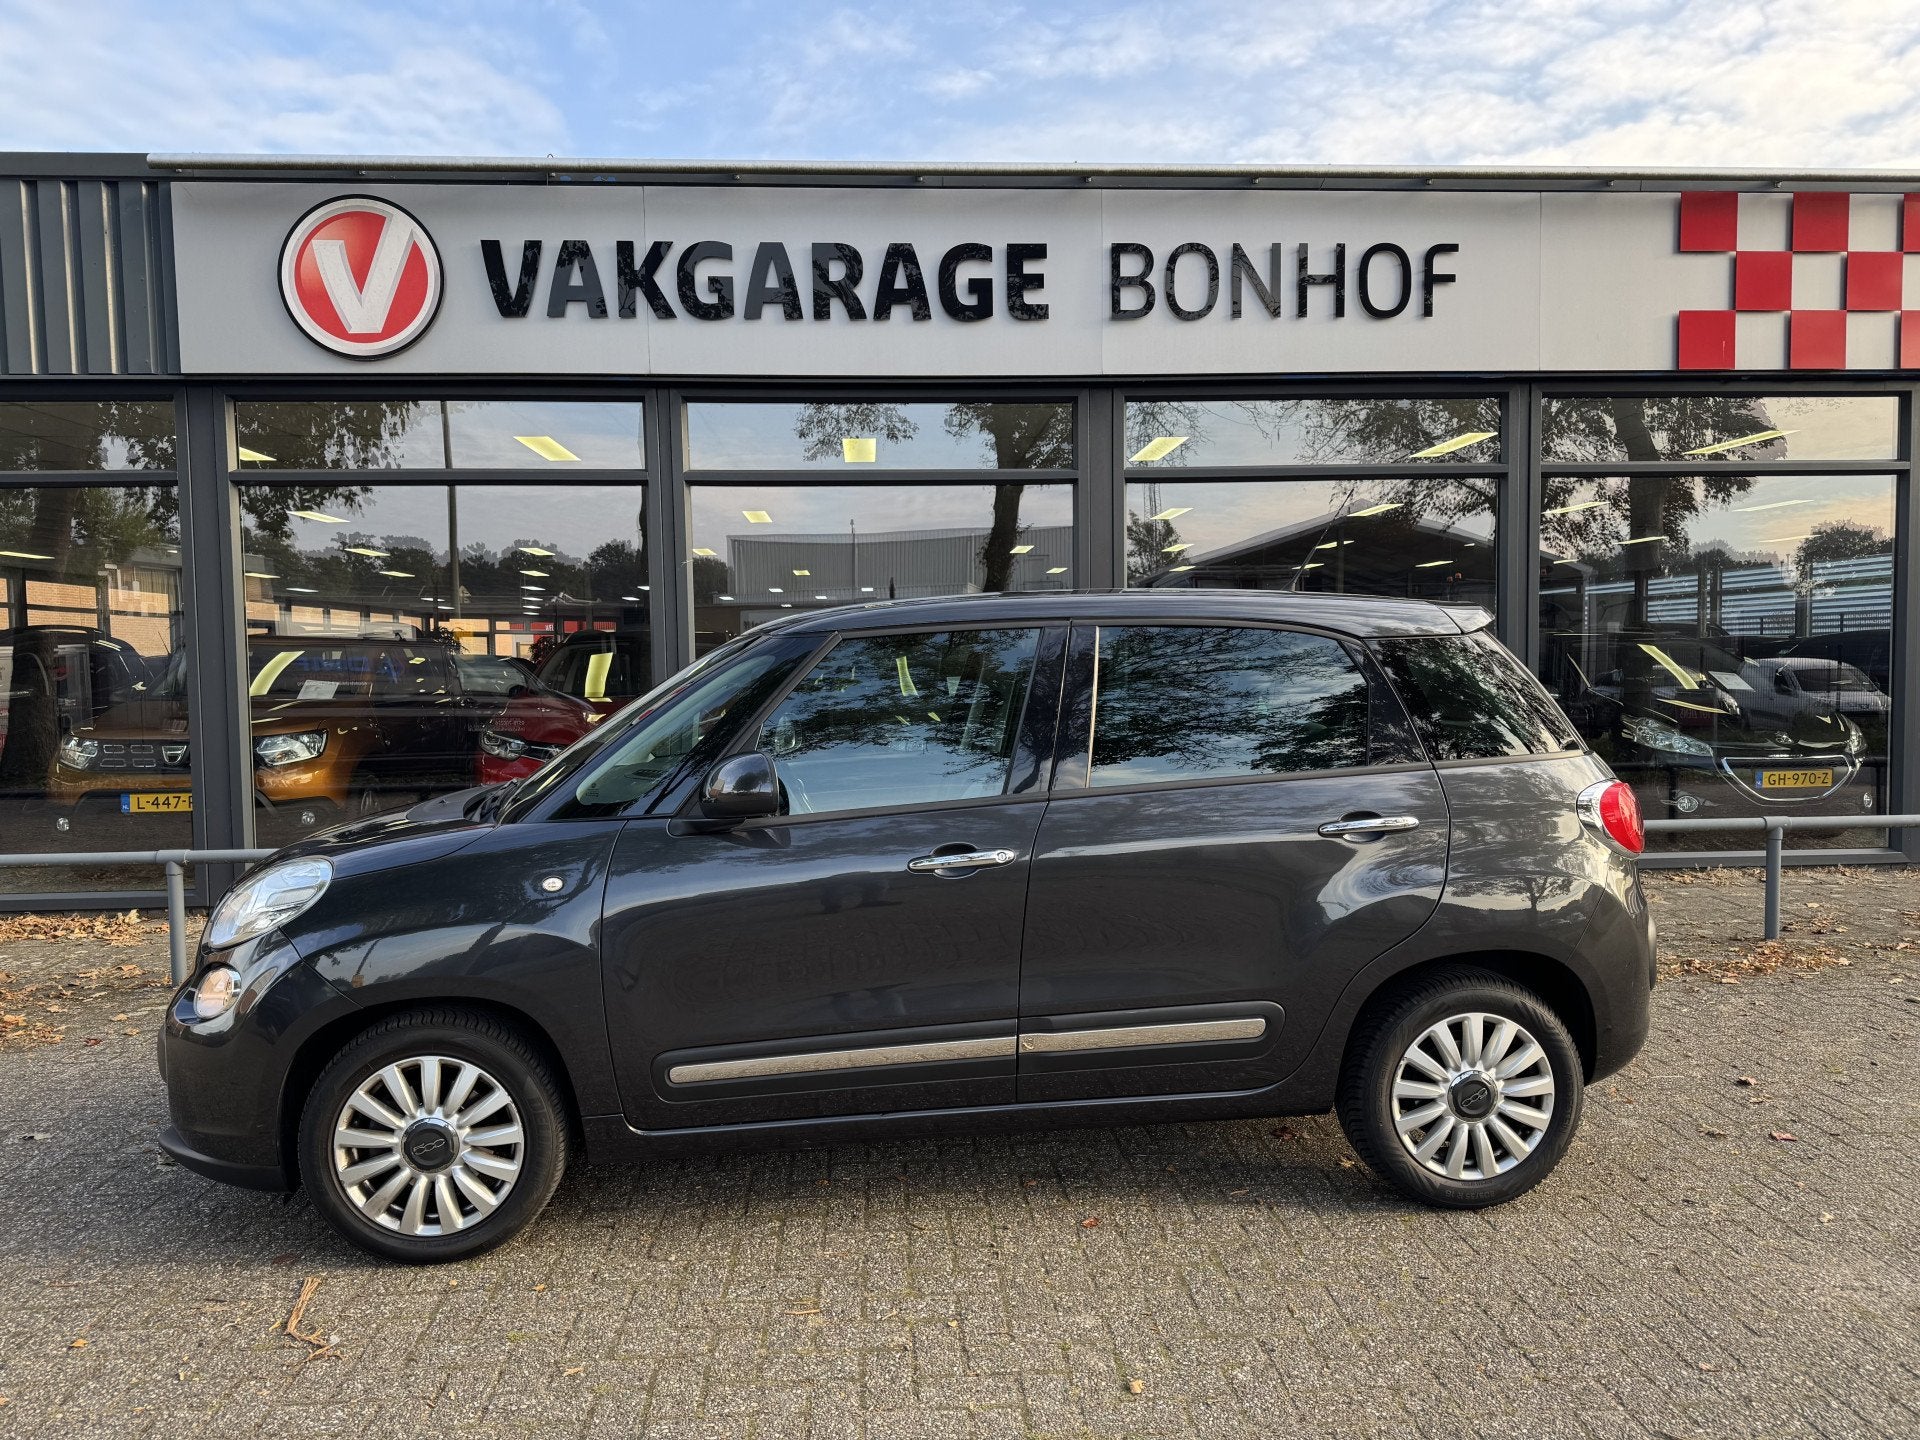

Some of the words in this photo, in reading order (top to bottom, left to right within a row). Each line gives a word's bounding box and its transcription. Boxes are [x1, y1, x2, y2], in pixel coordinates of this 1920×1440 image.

[312, 206, 414, 334] V
[480, 239, 1049, 323] VAKGARAGE
[1110, 242, 1459, 320] BONHOF
[1767, 772, 1829, 786] GH-970-Z
